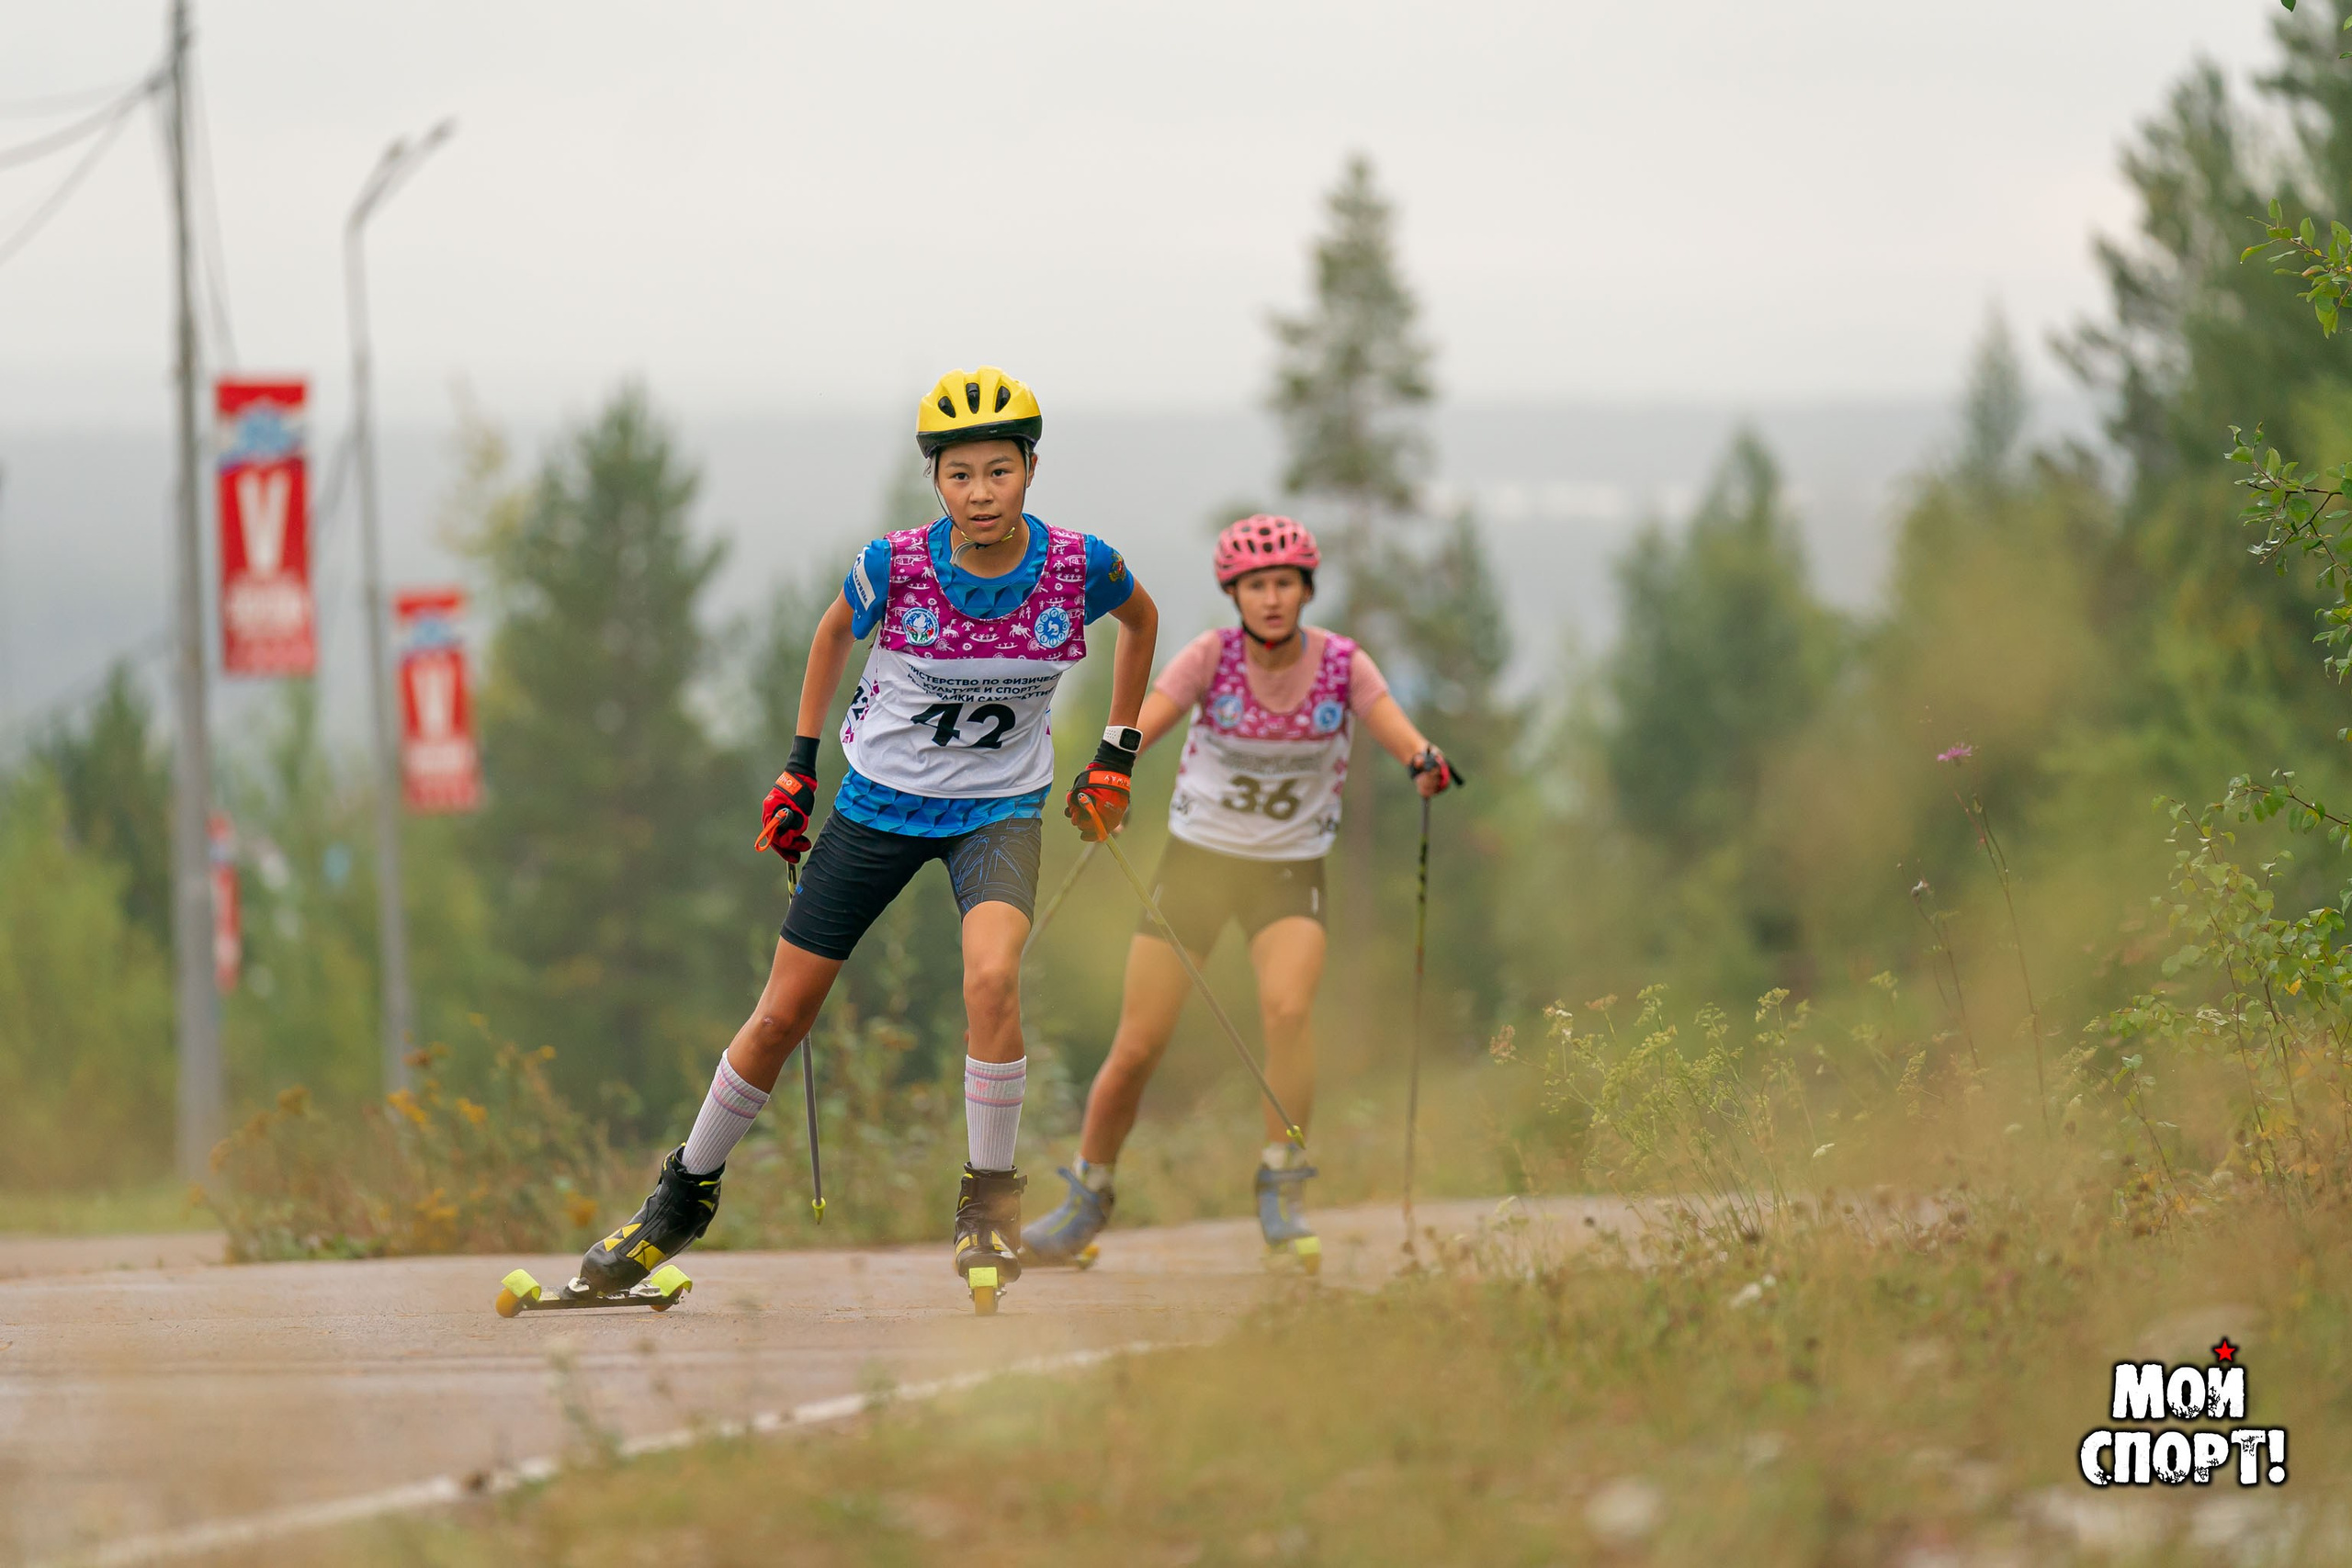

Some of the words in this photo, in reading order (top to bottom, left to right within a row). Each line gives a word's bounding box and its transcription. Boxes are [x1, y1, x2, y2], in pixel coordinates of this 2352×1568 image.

[922, 682, 980, 694] КУЛЬТУРЕ
[996, 684, 1041, 694] СПОРТУ
[910, 703, 1016, 750] 42
[1221, 775, 1301, 820] 36
